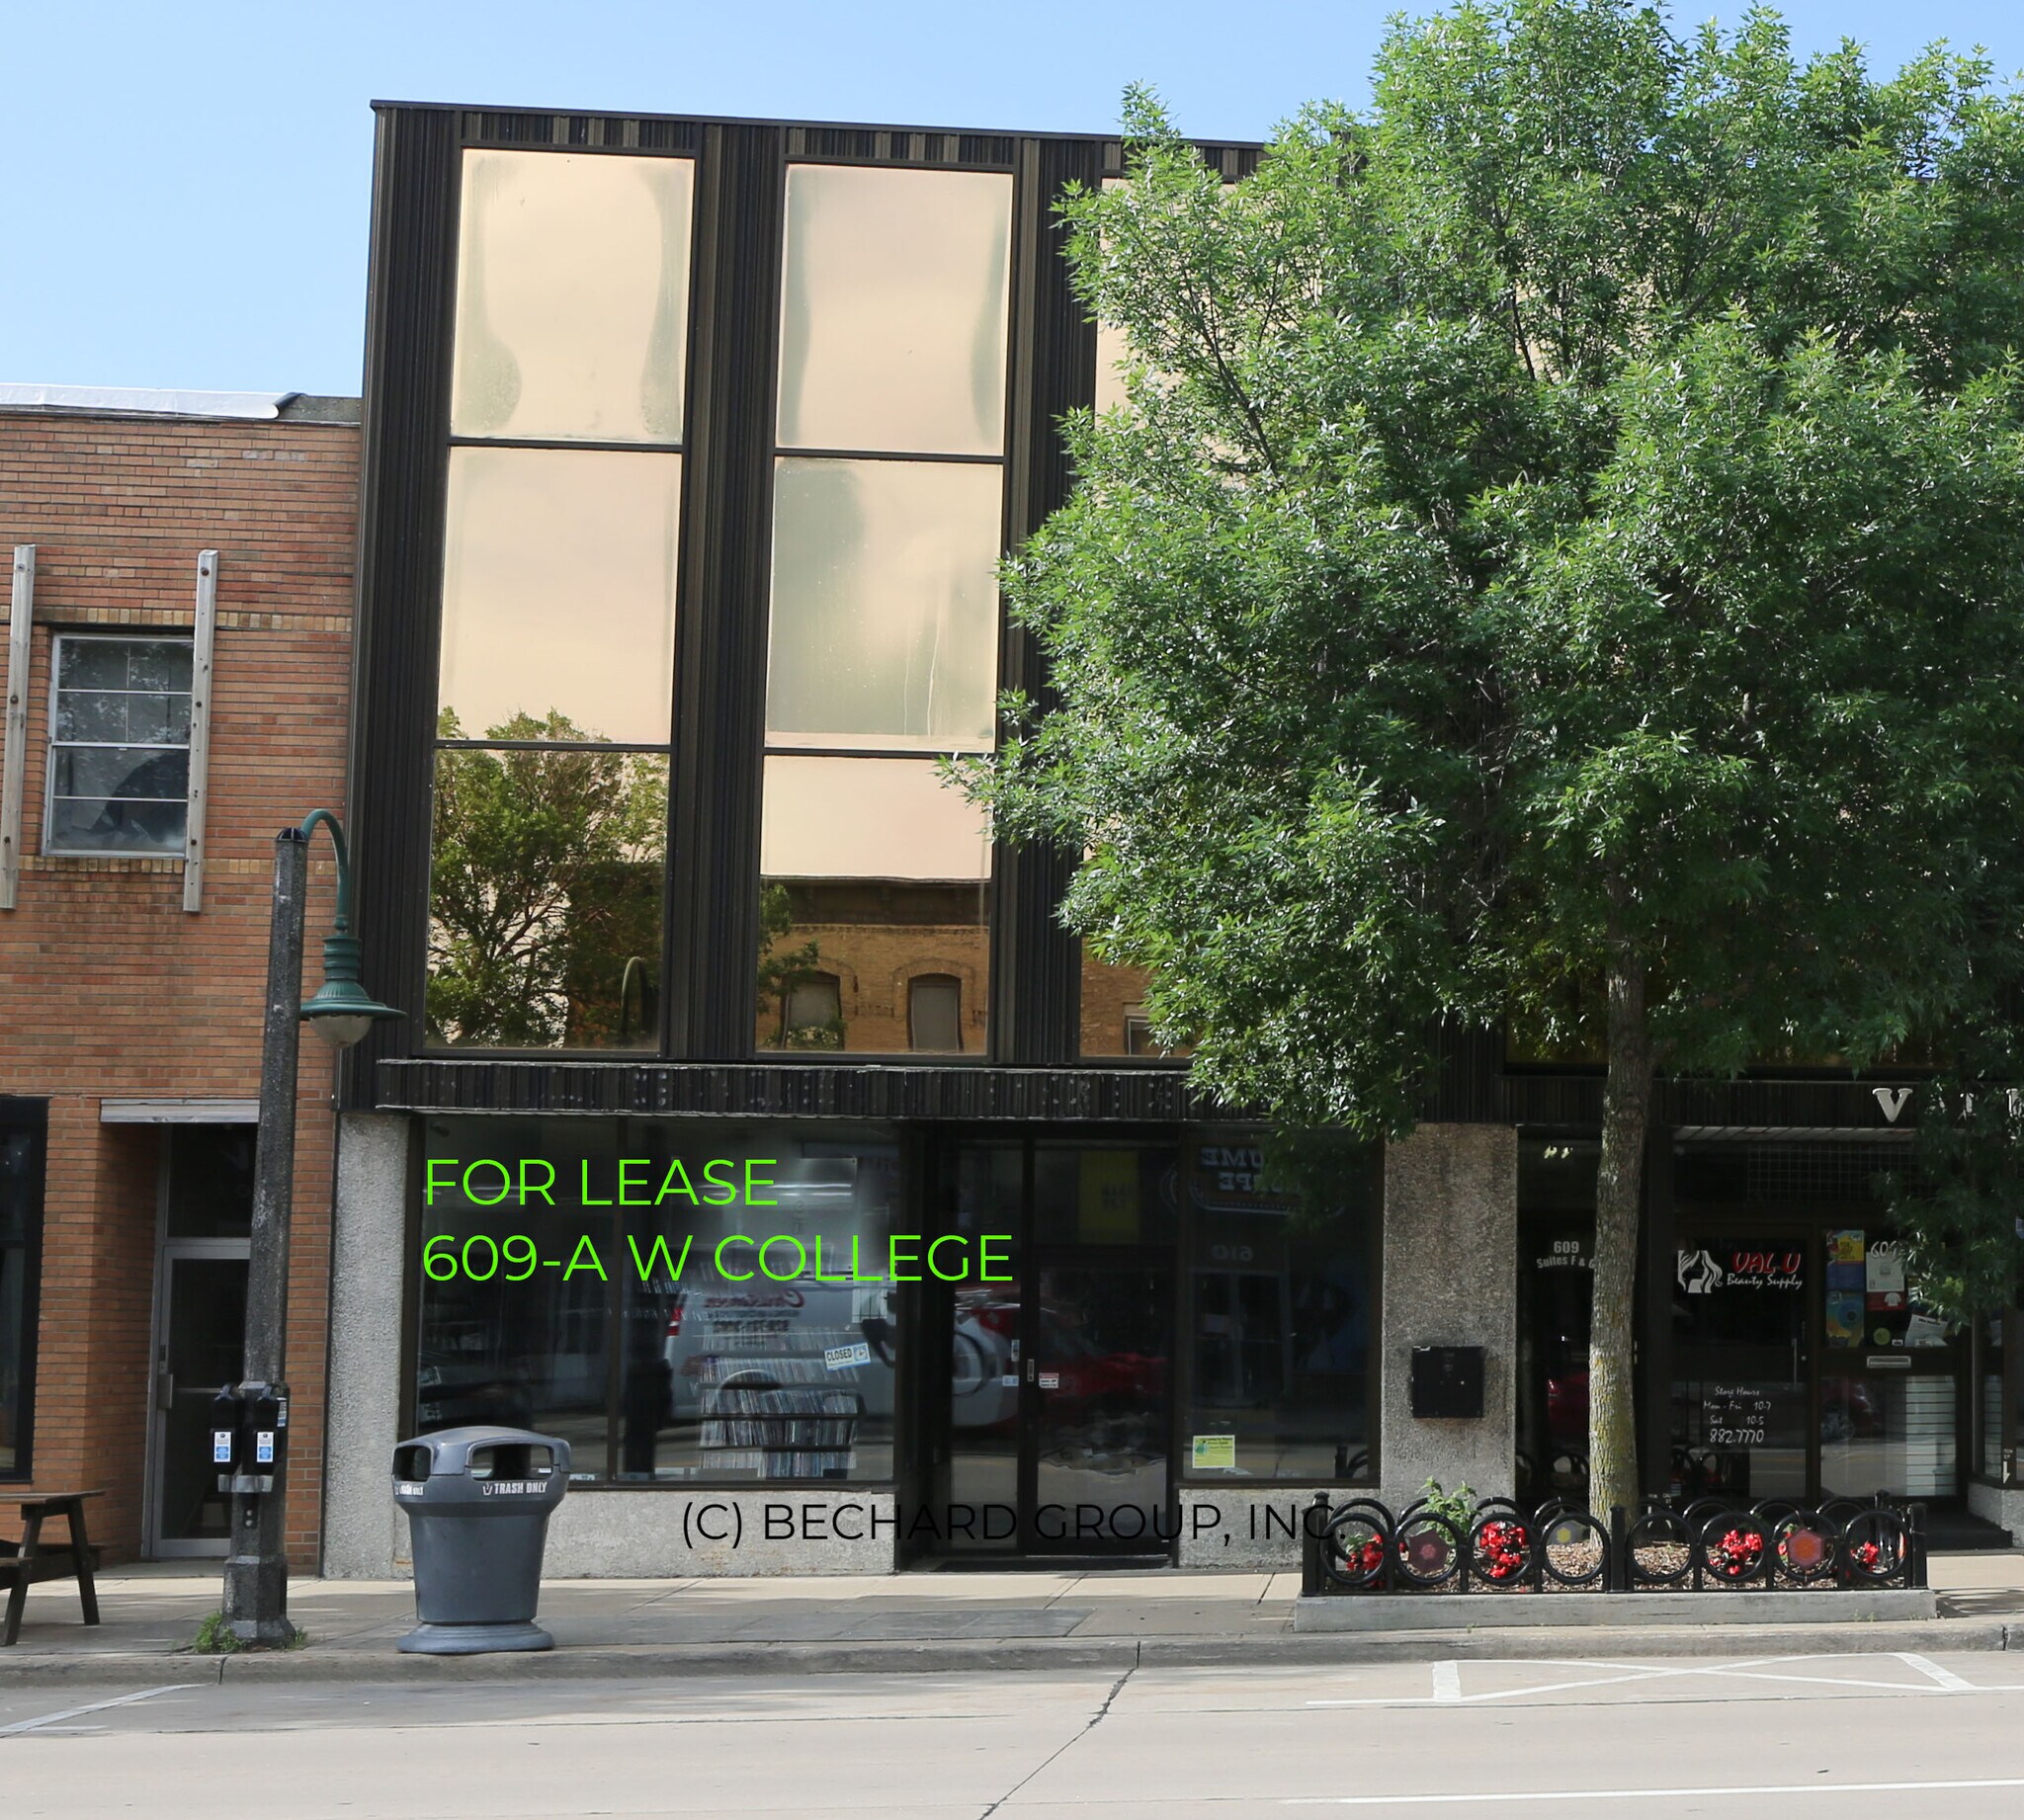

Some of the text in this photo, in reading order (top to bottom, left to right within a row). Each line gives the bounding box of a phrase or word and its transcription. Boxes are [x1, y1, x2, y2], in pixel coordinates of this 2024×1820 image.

[1554, 1240, 1579, 1254] 609
[1536, 1255, 1568, 1269] Suites
[1571, 1254, 1577, 1266] F
[1578, 1257, 1586, 1267] &
[1727, 1273, 1804, 1290] Beauty Supply
[826, 1347, 853, 1362] CLOSED
[494, 1481, 548, 1495] TRASH ONLY
